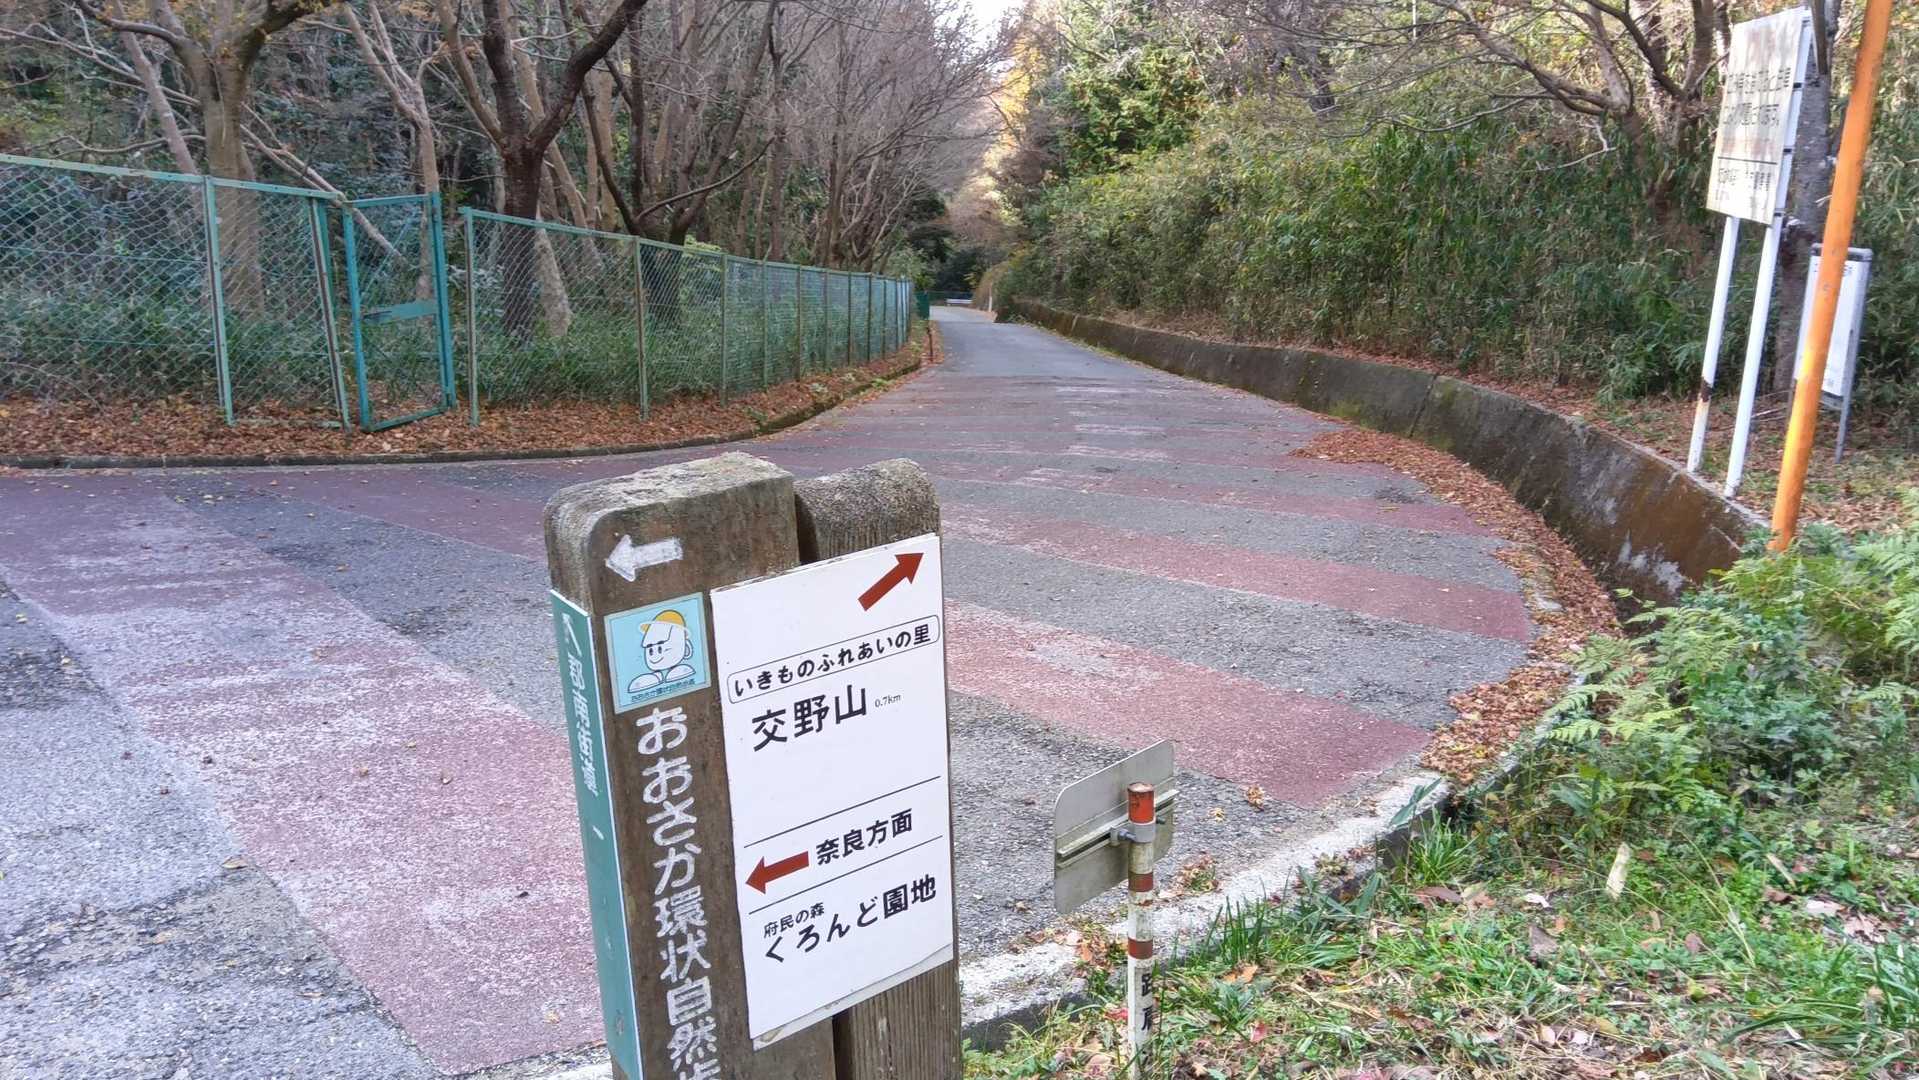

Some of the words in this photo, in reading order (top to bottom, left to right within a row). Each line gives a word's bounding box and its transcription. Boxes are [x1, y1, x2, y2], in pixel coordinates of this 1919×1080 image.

[734, 624, 931, 697] いきものふれあいの里
[751, 684, 868, 752] 交野山
[874, 694, 901, 708] 0.7km
[815, 808, 913, 866] 奈良方面
[763, 902, 825, 939] 府民の森
[765, 874, 937, 963] くろんど園地
